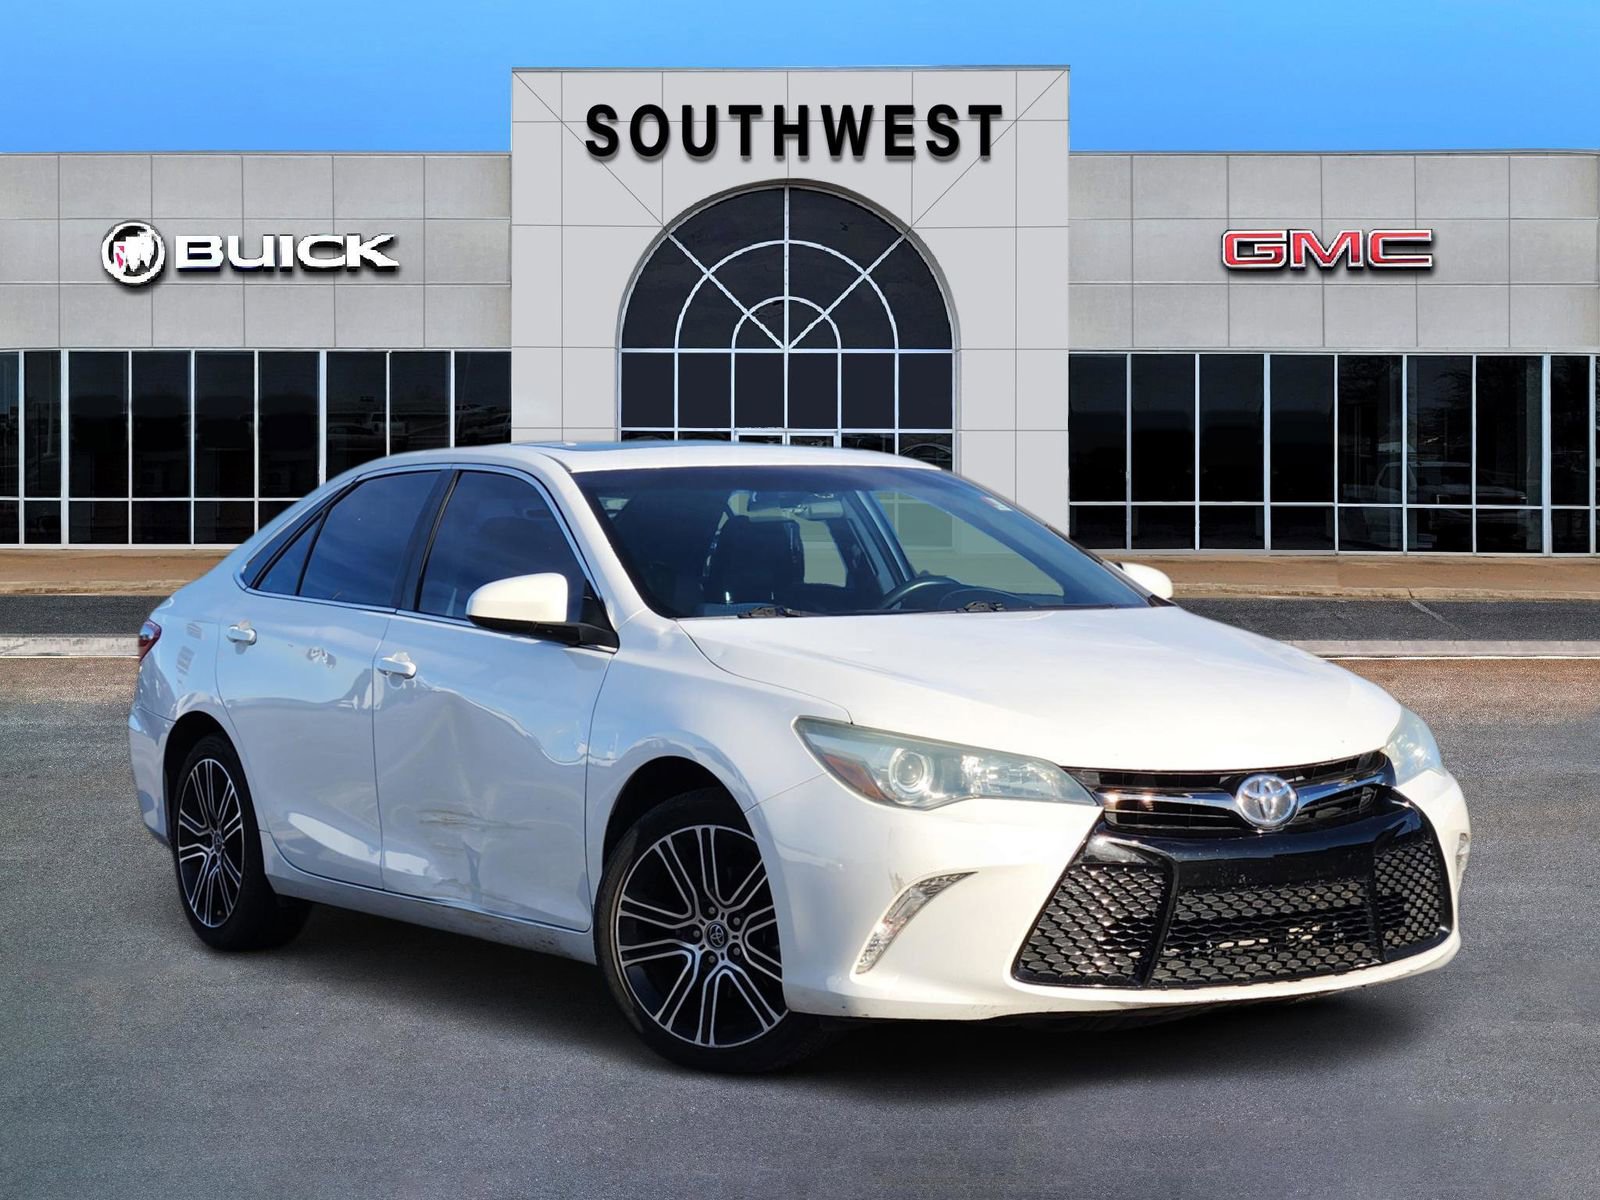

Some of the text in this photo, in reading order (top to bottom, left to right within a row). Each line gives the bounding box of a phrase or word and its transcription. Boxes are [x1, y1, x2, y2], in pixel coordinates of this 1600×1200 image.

[585, 104, 1003, 159] SOUTHWEST
[175, 233, 400, 271] BUICK
[1222, 229, 1433, 269] GMC
